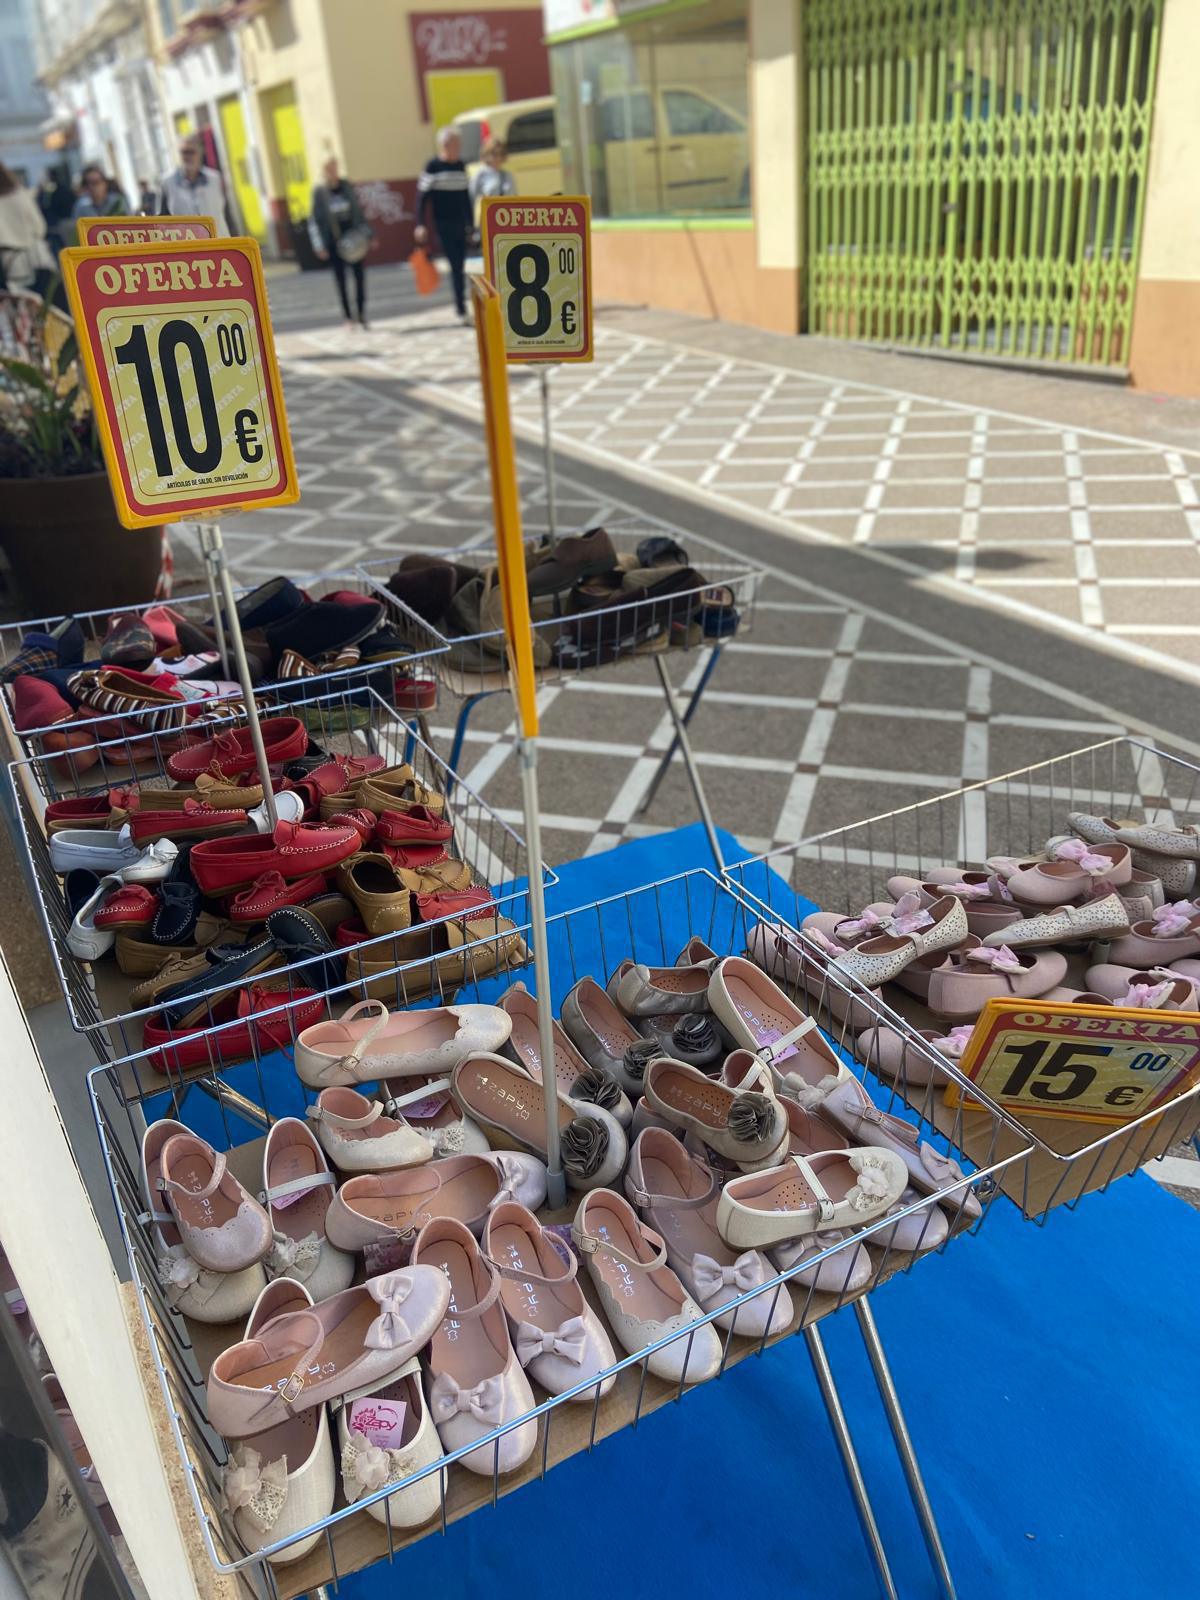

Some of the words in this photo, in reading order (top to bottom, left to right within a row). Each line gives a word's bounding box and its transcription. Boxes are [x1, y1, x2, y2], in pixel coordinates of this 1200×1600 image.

[495, 208, 578, 227] OFERTA
[94, 258, 243, 295] OFERTA
[168, 480, 191, 488] ARTÍCULOS
[222, 472, 248, 481] DEVOLUCIÓN
[1013, 1013, 1200, 1040] OFERTA
